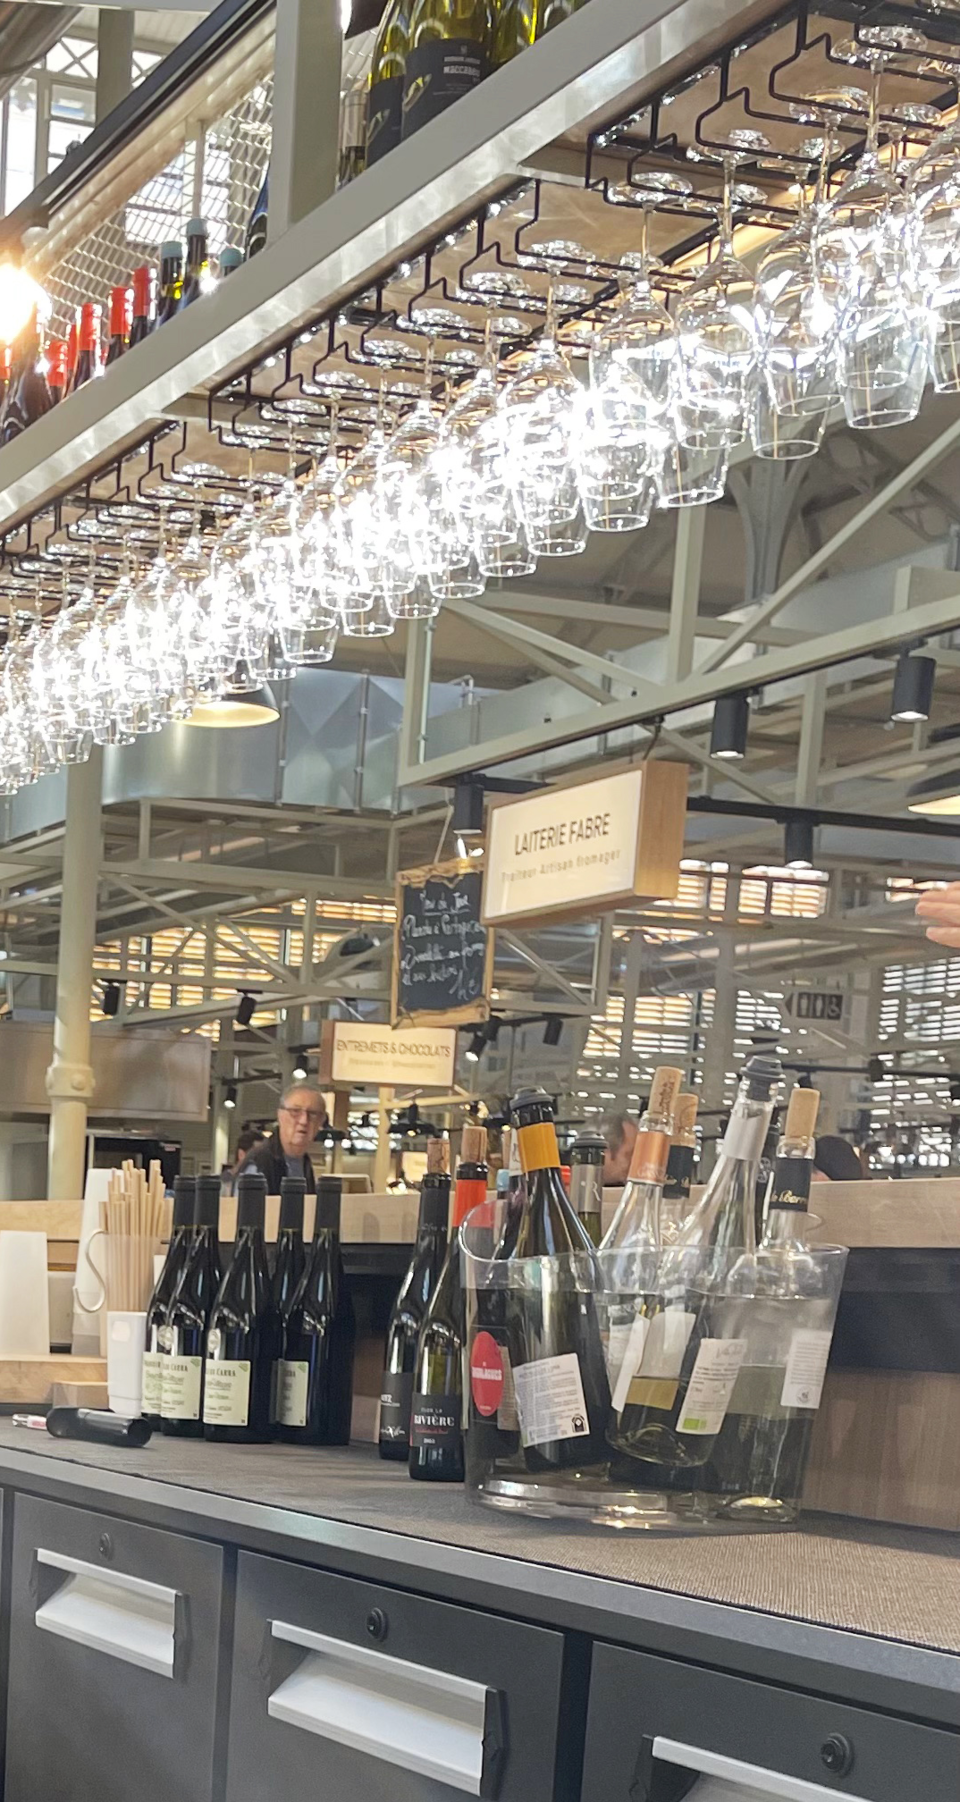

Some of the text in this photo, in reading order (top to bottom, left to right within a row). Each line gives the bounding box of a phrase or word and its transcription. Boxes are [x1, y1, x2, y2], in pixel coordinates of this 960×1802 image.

[515, 813, 611, 856] LAITERIE FABRE
[337, 1039, 389, 1055] ENTREMETS
[399, 1043, 451, 1058] CHOCOLATS
